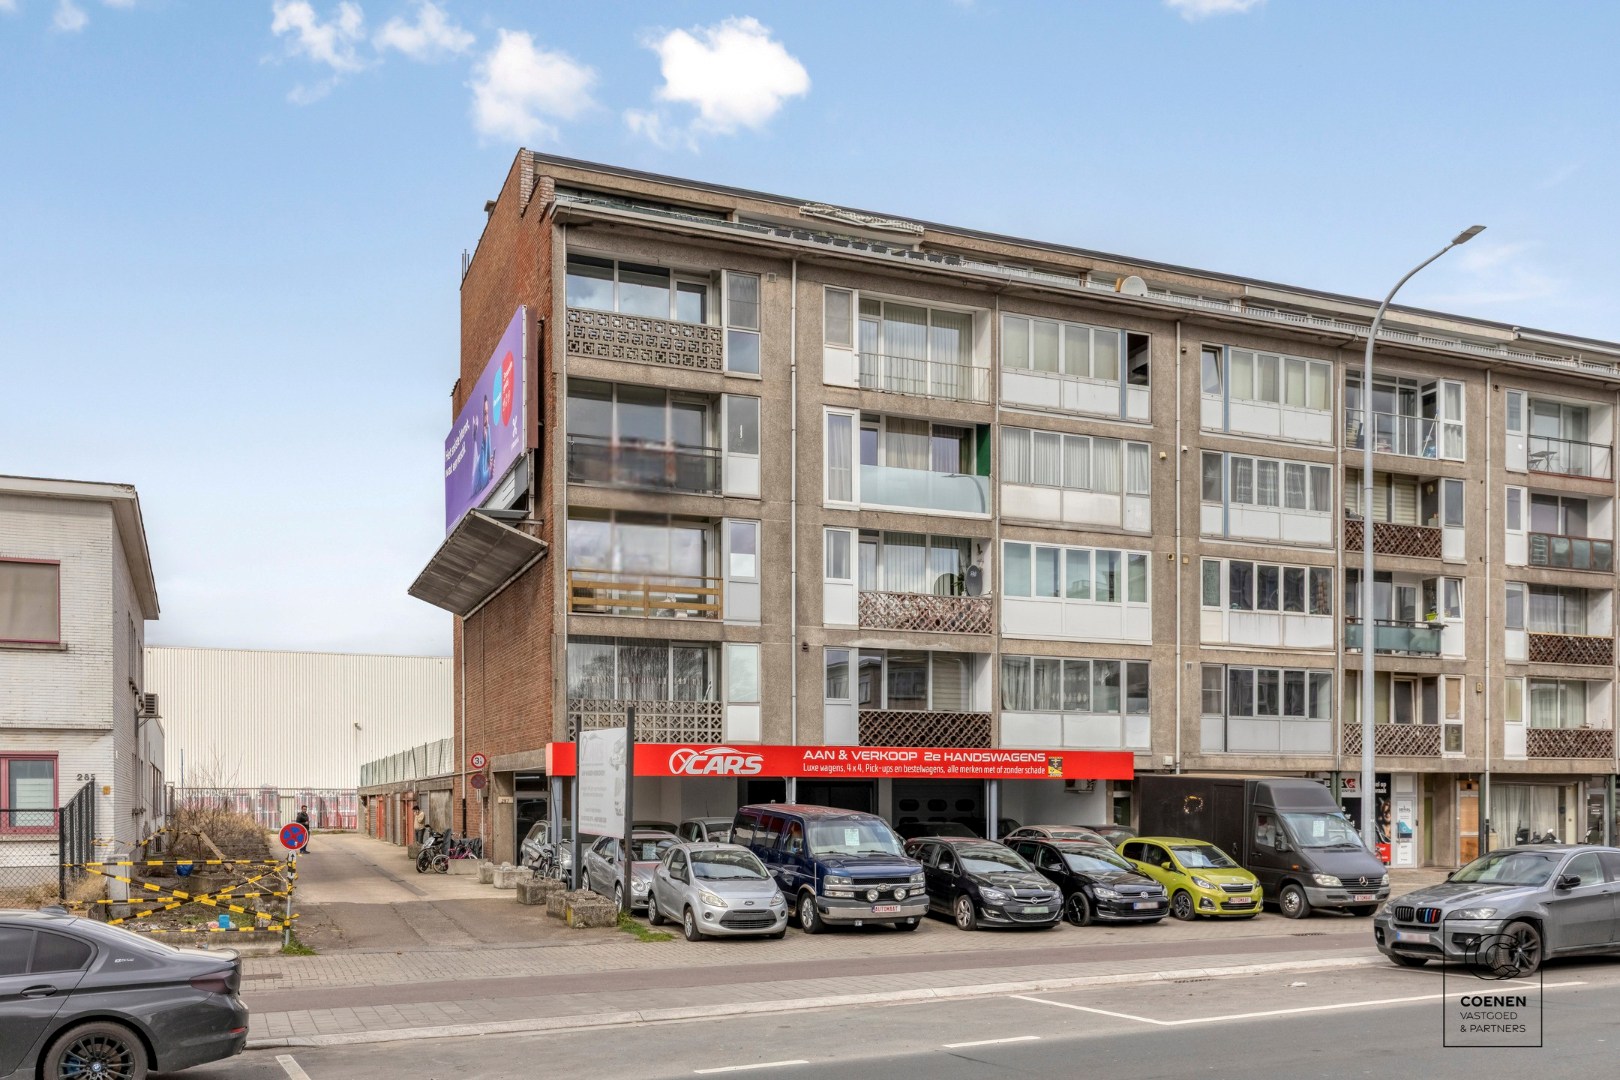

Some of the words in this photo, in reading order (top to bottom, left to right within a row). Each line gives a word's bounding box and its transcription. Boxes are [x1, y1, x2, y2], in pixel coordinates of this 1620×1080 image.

[803, 750, 835, 760] AAN
[838, 750, 848, 760] &
[851, 750, 918, 761] VERKOOP
[924, 752, 941, 761] 2e
[944, 752, 1046, 762] HANDSWAGENS
[803, 763, 819, 772] Luxe
[820, 764, 846, 774] wagens,
[866, 763, 893, 774] Pick-ups
[904, 764, 946, 775] bestelwagens,
[947, 765, 959, 773] alle
[959, 765, 983, 774] merken
[983, 766, 996, 774] met
[996, 766, 1004, 774] of
[1003, 766, 1025, 774] zonder
[1024, 766, 1046, 775] schade
[76, 773, 96, 782] 285
